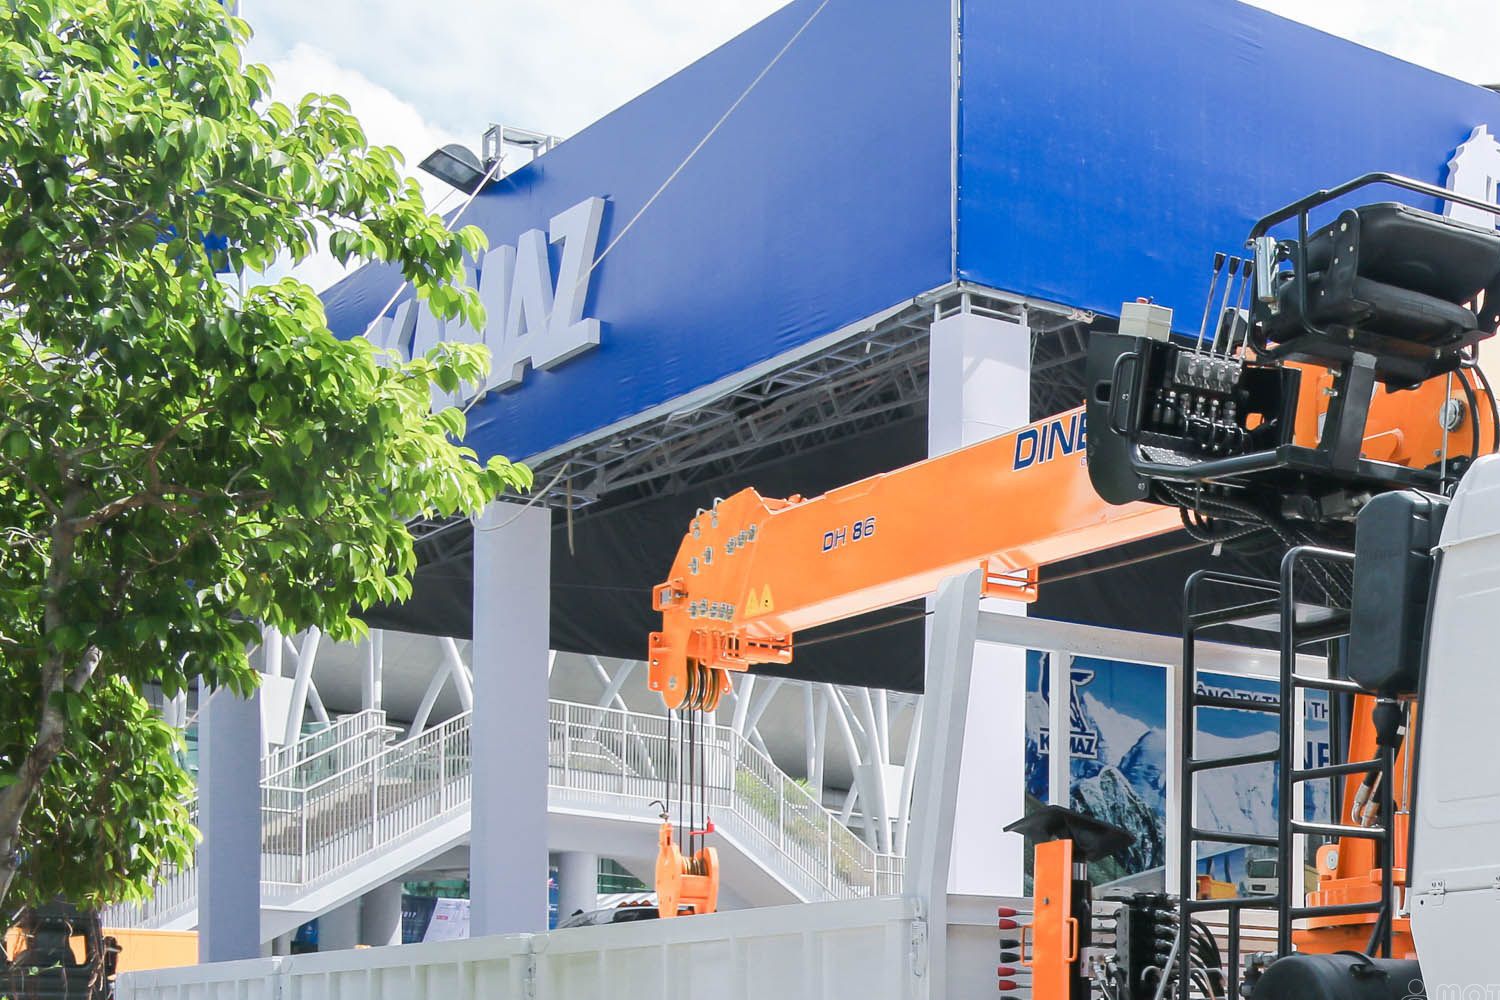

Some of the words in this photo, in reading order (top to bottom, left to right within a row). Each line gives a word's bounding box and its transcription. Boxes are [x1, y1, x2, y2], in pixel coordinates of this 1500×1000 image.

[822, 526, 848, 553] DH
[852, 516, 876, 541] 86
[1040, 733, 1096, 755] KAZ
